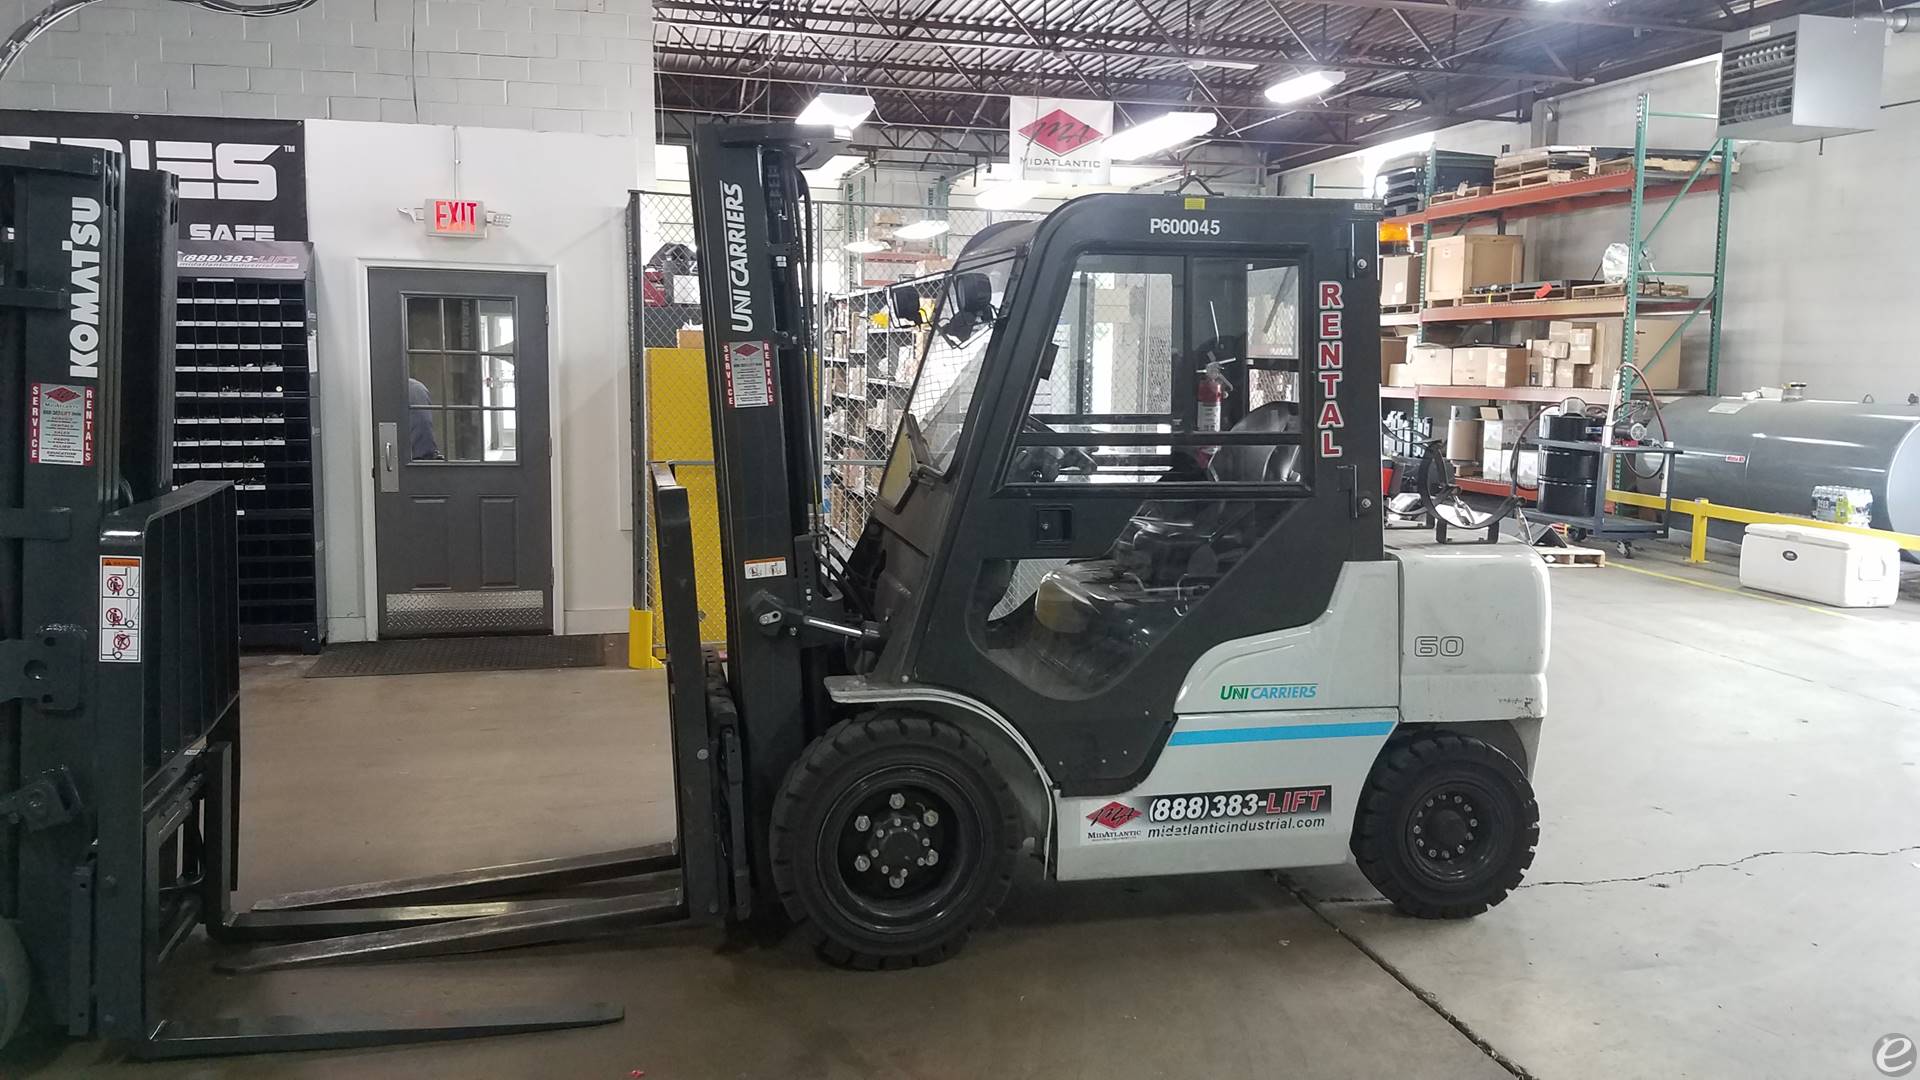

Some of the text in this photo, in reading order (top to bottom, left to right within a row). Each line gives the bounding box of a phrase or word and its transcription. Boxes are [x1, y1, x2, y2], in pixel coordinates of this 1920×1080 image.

[189, 223, 275, 242] SAFE
[435, 201, 477, 232] EXIT
[1150, 218, 1221, 235] P600045
[62, 196, 101, 378] KOMATSU
[723, 345, 734, 405] SERVICE
[763, 343, 774, 402] RENTALS
[1318, 281, 1344, 459] RENTAL
[31, 385, 39, 459] SERVICE
[84, 389, 93, 462] RENTALS
[1414, 635, 1465, 658] 60
[1147, 816, 1326, 838] midatlanticindustrial.com
